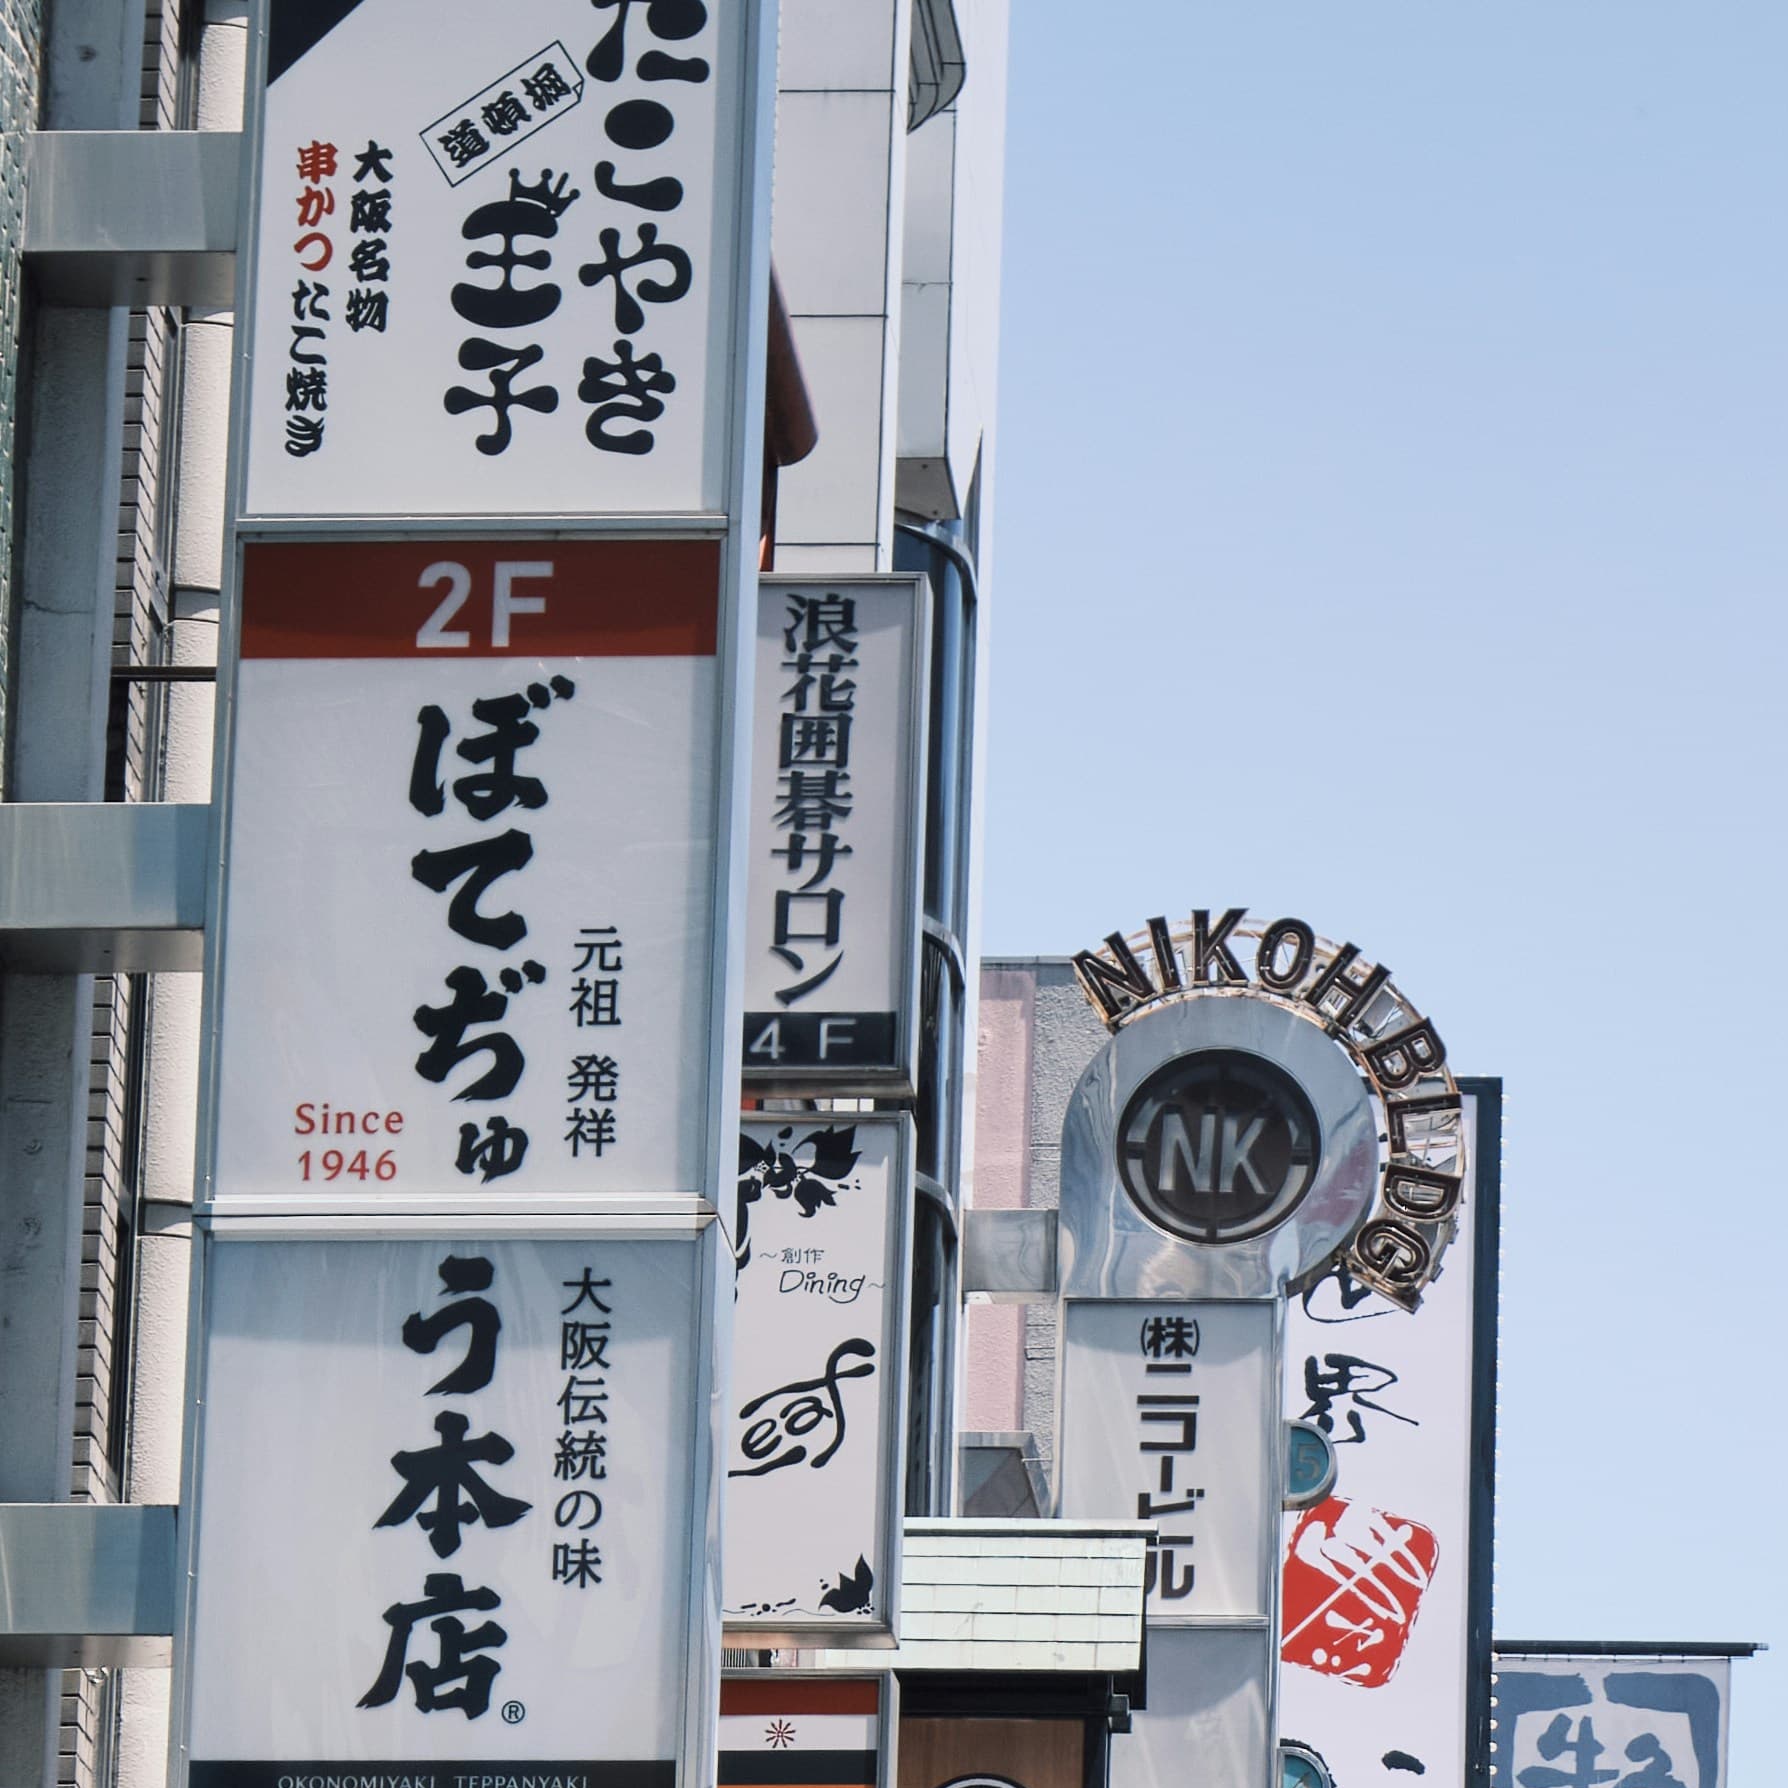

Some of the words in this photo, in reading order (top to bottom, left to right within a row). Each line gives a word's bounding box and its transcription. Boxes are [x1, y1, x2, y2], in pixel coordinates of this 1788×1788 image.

[439, 64, 575, 170] 道頓堀
[284, 139, 338, 458] 串かつたこ焼き
[346, 140, 394, 334] 大阪名物
[445, 168, 562, 456] 王子
[415, 560, 555, 649] 2F
[770, 592, 860, 1006] 浪花囲碁サロン
[1071, 907, 1391, 1033] NIKOH
[295, 1102, 404, 1136] Since
[297, 1148, 398, 1183] 1946
[1157, 1112, 1273, 1196] NK
[1355, 1016, 1464, 1291] BLDG
[777, 1268, 867, 1303] Dining
[551, 1268, 614, 1590] 大阪伝統の味
